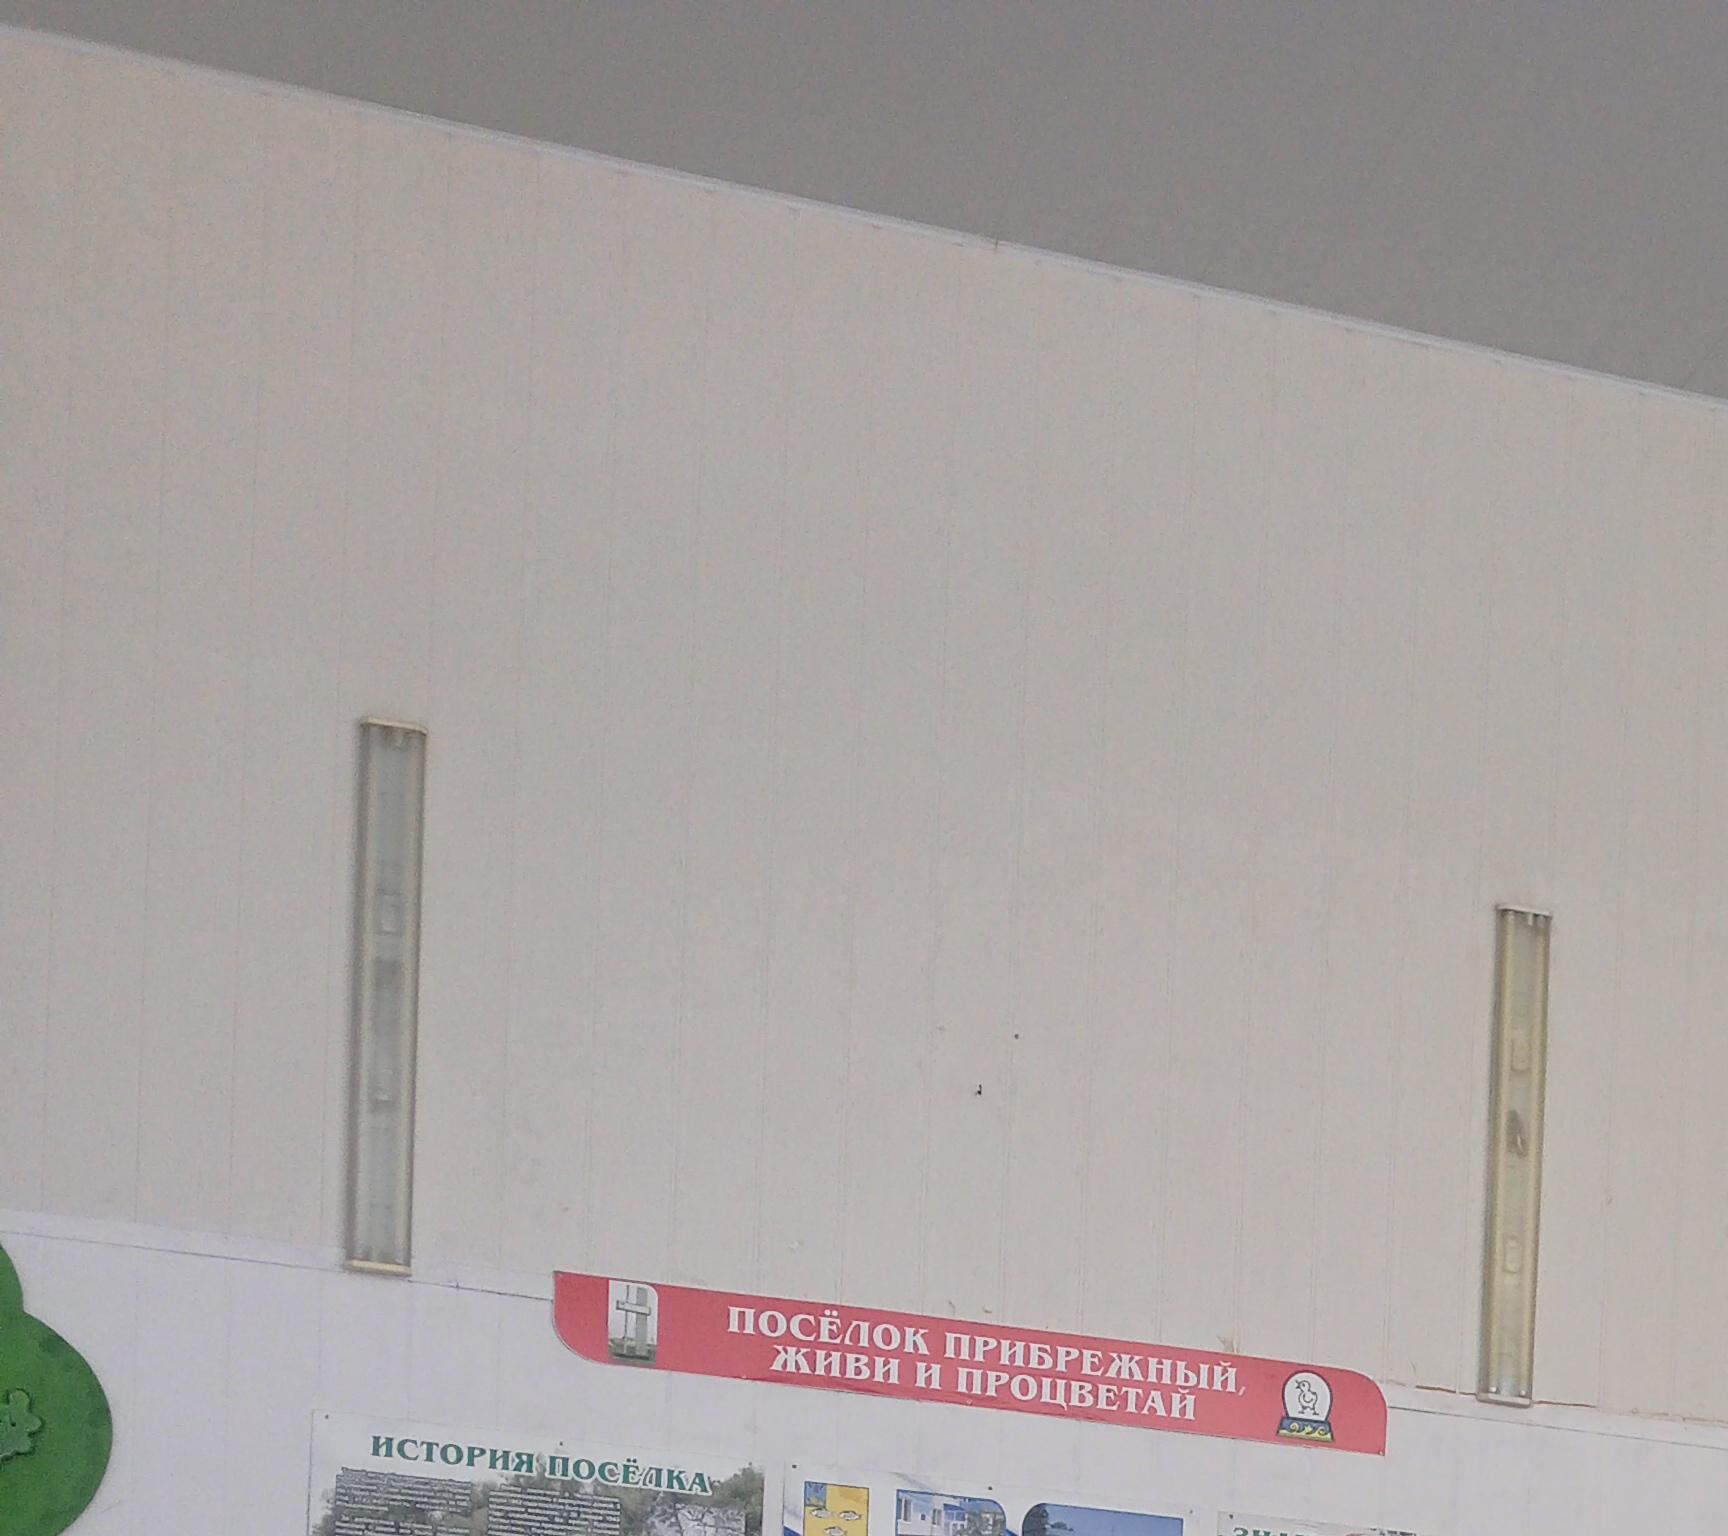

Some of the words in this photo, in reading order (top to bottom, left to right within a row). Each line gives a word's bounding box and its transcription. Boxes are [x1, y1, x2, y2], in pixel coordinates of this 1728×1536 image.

[727, 1306, 930, 1355] ПОСЁЛОК
[769, 1345, 901, 1385] ЖИВИ
[915, 1361, 942, 1391] И
[956, 1366, 1197, 1421] ПРОЦВЕТАЙ
[370, 1435, 534, 1474] ИСТОРИЯ
[548, 1455, 712, 1493] ПОСЁЛКА
